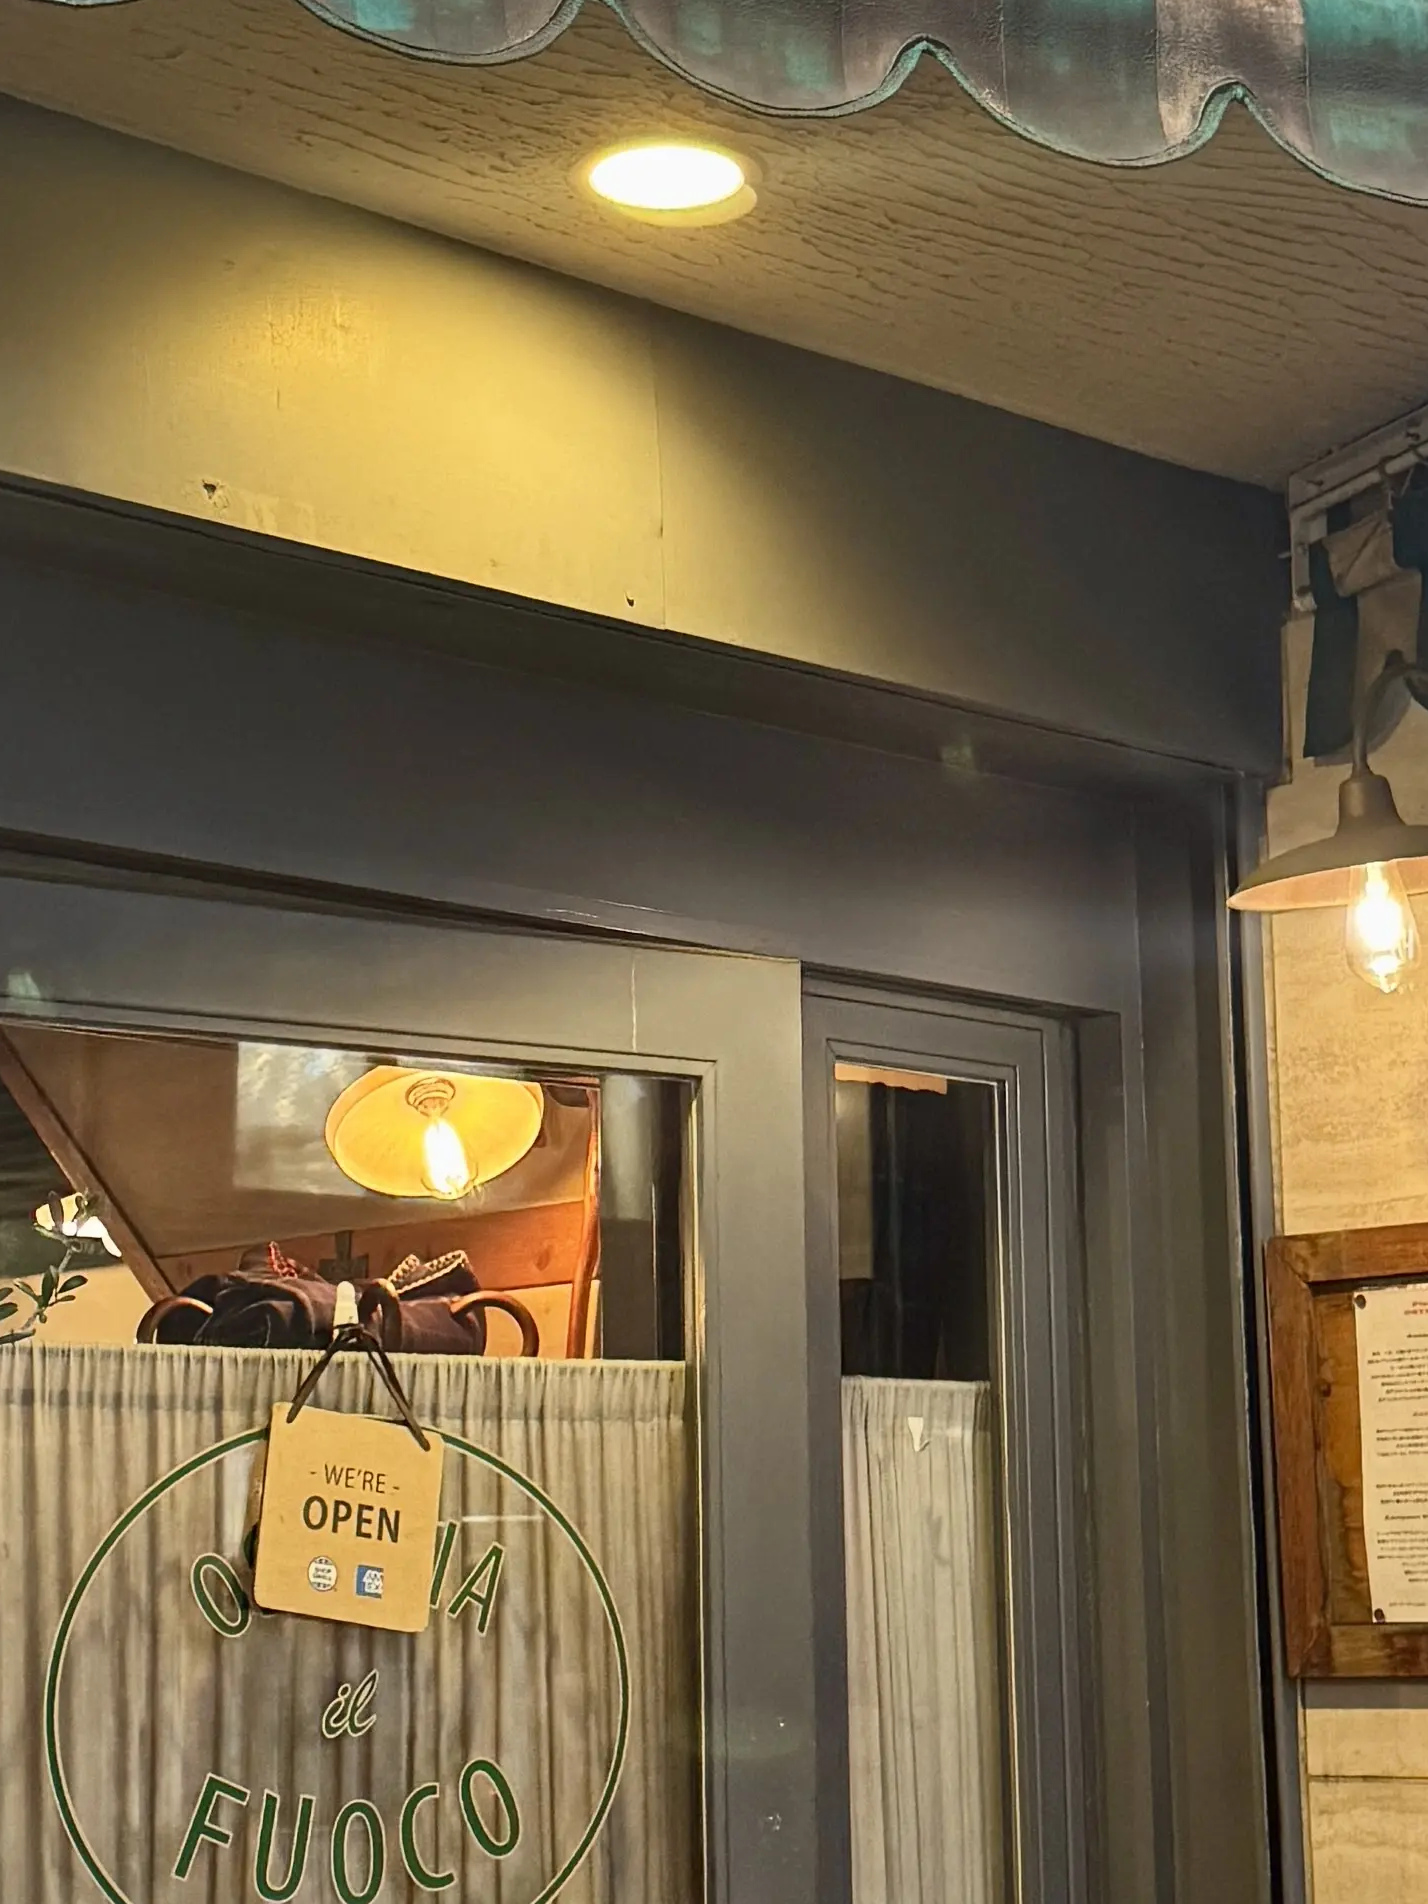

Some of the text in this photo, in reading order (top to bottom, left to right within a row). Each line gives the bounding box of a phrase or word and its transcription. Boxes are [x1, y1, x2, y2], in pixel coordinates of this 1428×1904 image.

[324, 1463, 387, 1494] WE'RE
[303, 1495, 401, 1544] OPEN
[322, 1668, 379, 1742] il
